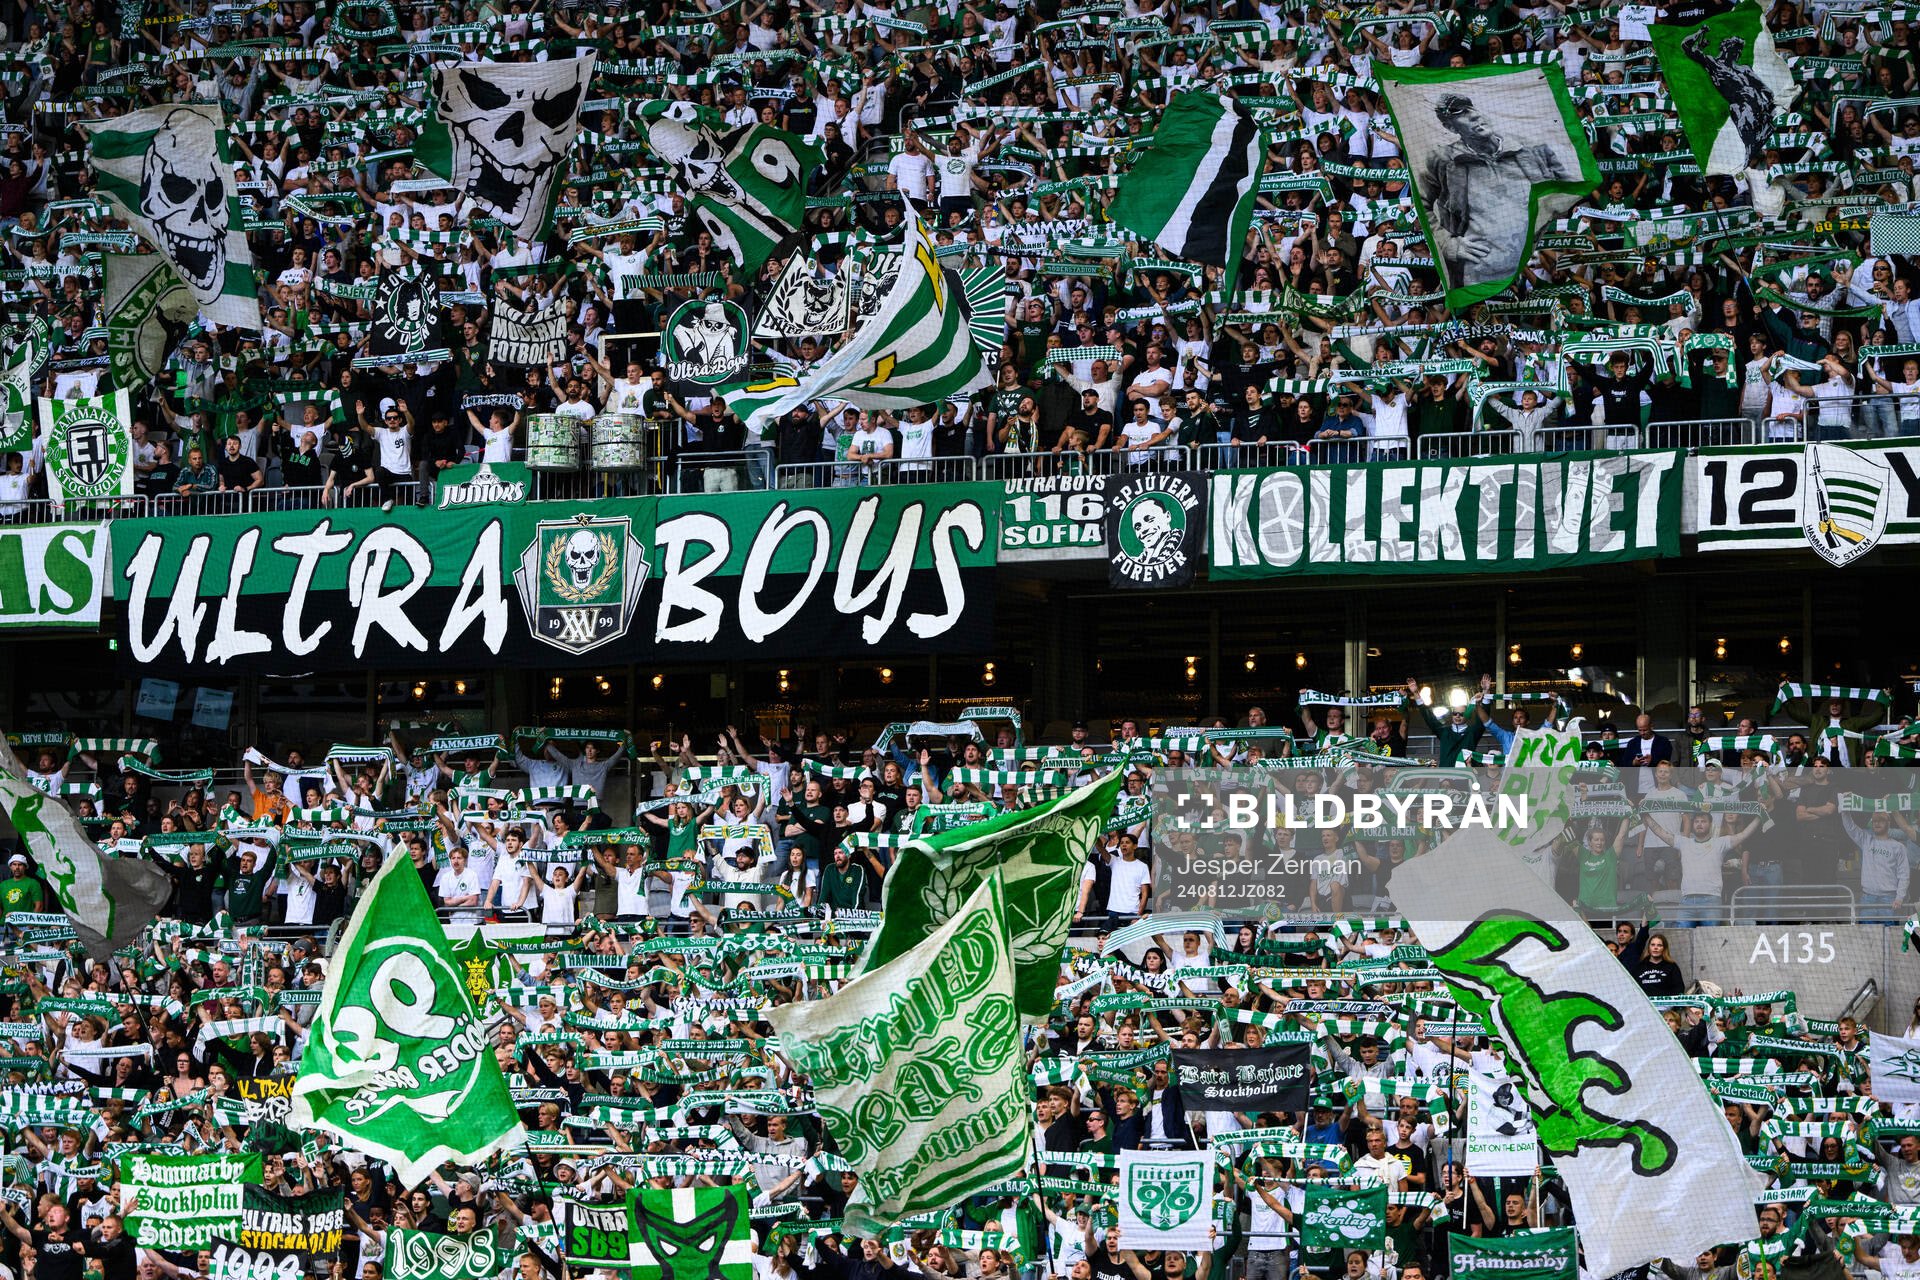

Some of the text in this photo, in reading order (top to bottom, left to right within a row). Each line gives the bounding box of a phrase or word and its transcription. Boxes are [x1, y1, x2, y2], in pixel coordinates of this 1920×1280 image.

[492, 315, 568, 342] MODERNA
[488, 338, 568, 364] FOTBOLLEN
[53, 408, 123, 440] HAMMARBY
[55, 462, 124, 498] STOCKHOLM
[1005, 473, 1107, 494] ULTRA BOYS
[1704, 458, 1798, 527] 12
[1005, 493, 1106, 522] 116
[1212, 451, 1677, 568] KOLLEKTIVET
[1004, 524, 1104, 547] SOFIA
[1806, 522, 1874, 562] HAMMARBY STHLM
[656, 493, 986, 644] BOYS
[1112, 549, 1188, 582] FOREVER
[126, 516, 509, 665] ULTRA
[549, 618, 561, 630] 19
[600, 616, 613, 628] 99
[431, 736, 498, 750] HAMMARBY
[555, 728, 570, 738] Det
[571, 729, 584, 738] är
[585, 730, 596, 738] vi
[1391, 825, 1416, 837] BAJEN
[707, 880, 775, 894] FORZA BAJEN
[9, 914, 36, 928] SISTA
[730, 908, 801, 920] BAJEN FANS
[651, 939, 673, 949] This
[1750, 932, 1836, 964] A135
[568, 955, 624, 968] HAMMARBY
[1178, 1063, 1304, 1089] Bara Bajare
[1204, 1083, 1279, 1100] Stockholm
[1260, 1126, 1284, 1138] JAG
[1469, 1142, 1536, 1153] BEAT ON THE BRAT
[131, 1156, 245, 1185] Hammarby
[1137, 1166, 1197, 1181] nitton
[1812, 1163, 1841, 1176] BAJEN
[1030, 1177, 1080, 1190] KENNEDY
[1763, 1189, 1808, 1201] JAG STARK
[136, 1188, 239, 1217] Stockholm
[1136, 1184, 1195, 1212] 96
[242, 1209, 304, 1234] ULTRAS
[572, 1208, 628, 1231] ULTRA
[1305, 1210, 1385, 1229] Ekenlaget
[138, 1216, 239, 1248] Söderort
[390, 1228, 496, 1280] 1998
[1453, 1251, 1569, 1274] Hammarby
